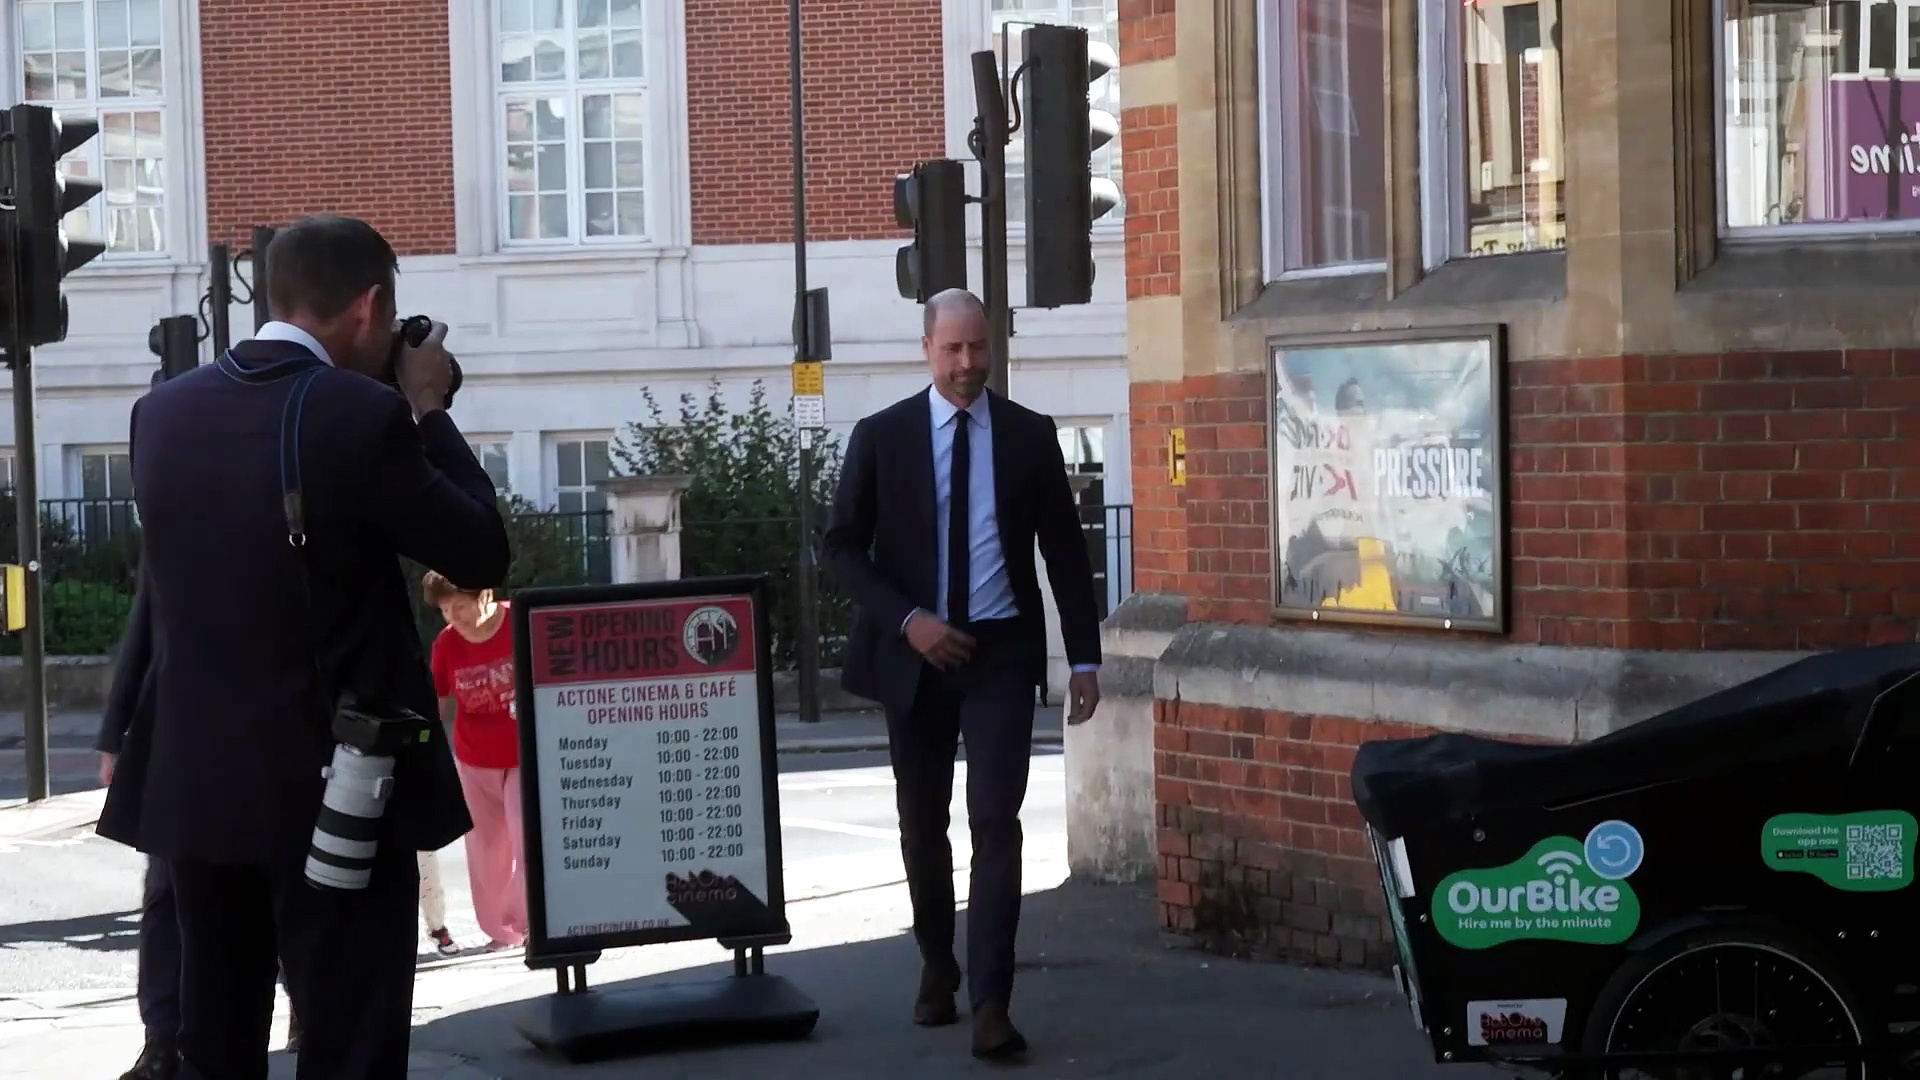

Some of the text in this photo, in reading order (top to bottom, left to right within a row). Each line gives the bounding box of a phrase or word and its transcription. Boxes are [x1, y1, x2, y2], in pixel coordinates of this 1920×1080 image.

[1374, 448, 1483, 497] PRESSURE
[580, 608, 676, 638] OPENING
[547, 615, 576, 676] NEW
[580, 635, 679, 673] HOURS
[557, 677, 737, 707] ACTONE CINEMA & CAFÉ
[588, 701, 708, 725] OPENING HOURS
[559, 735, 608, 750] Monday
[656, 729, 690, 745] 10:00
[702, 726, 738, 741] 22:00
[560, 755, 612, 771] Tuesday
[657, 749, 691, 764] 10:00
[704, 746, 739, 761] 22:00
[560, 774, 633, 790] Wednesday
[658, 768, 692, 784] 10:00
[704, 765, 740, 780] 22:00
[561, 794, 621, 810] Thursday
[659, 788, 693, 804] 10:00
[705, 784, 741, 801] 22:00
[562, 816, 602, 830] Friday
[660, 807, 694, 823] 10:00
[706, 804, 742, 820] 22:00
[563, 834, 621, 850] Saturday
[660, 827, 695, 843] 10:00
[707, 824, 743, 840] 22:00
[564, 854, 610, 870] Sunday
[661, 847, 696, 863] 10:00
[708, 843, 744, 859] 22:00
[1448, 874, 1620, 914] OurBike
[1458, 916, 1611, 930] Hire me by the minute
